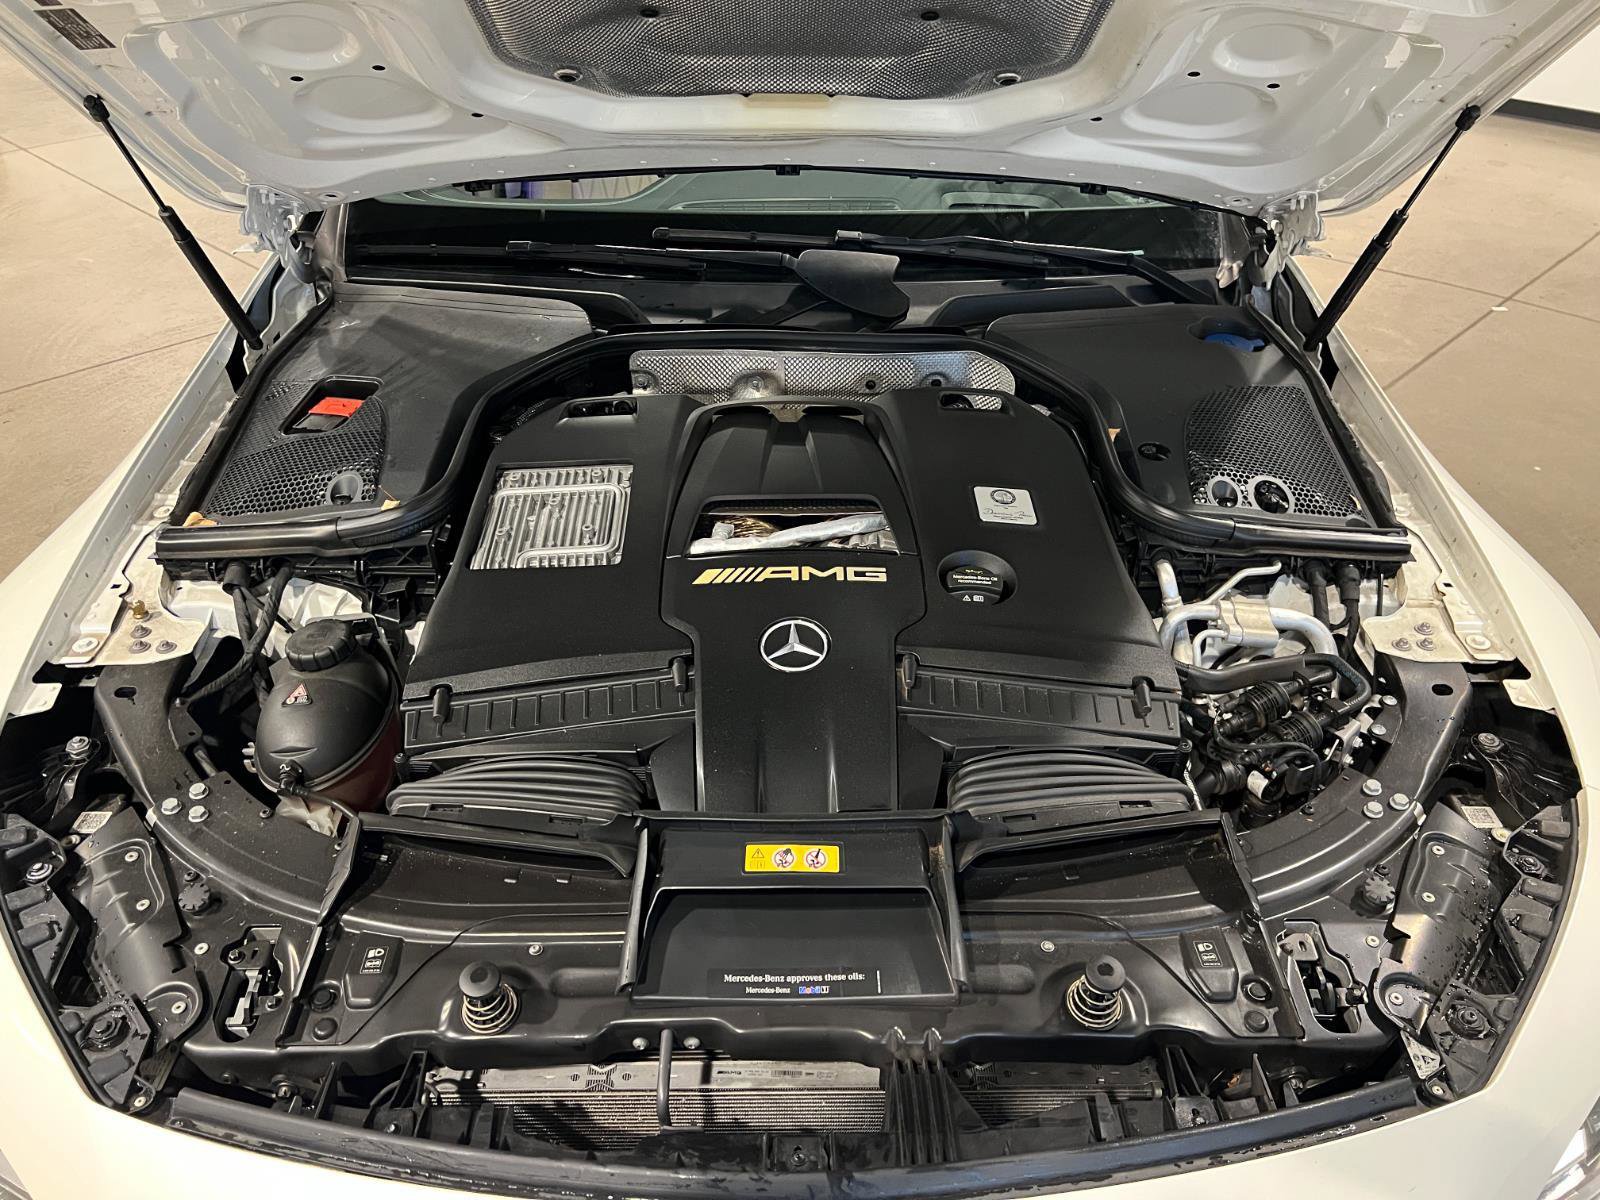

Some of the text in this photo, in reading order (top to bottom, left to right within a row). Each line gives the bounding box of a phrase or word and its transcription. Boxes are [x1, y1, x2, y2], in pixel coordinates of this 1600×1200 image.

[754, 566, 887, 582] AMG
[724, 972, 866, 984] Mercedes-Benz approves these oils:
[745, 986, 791, 994] Mercedes-Benz
